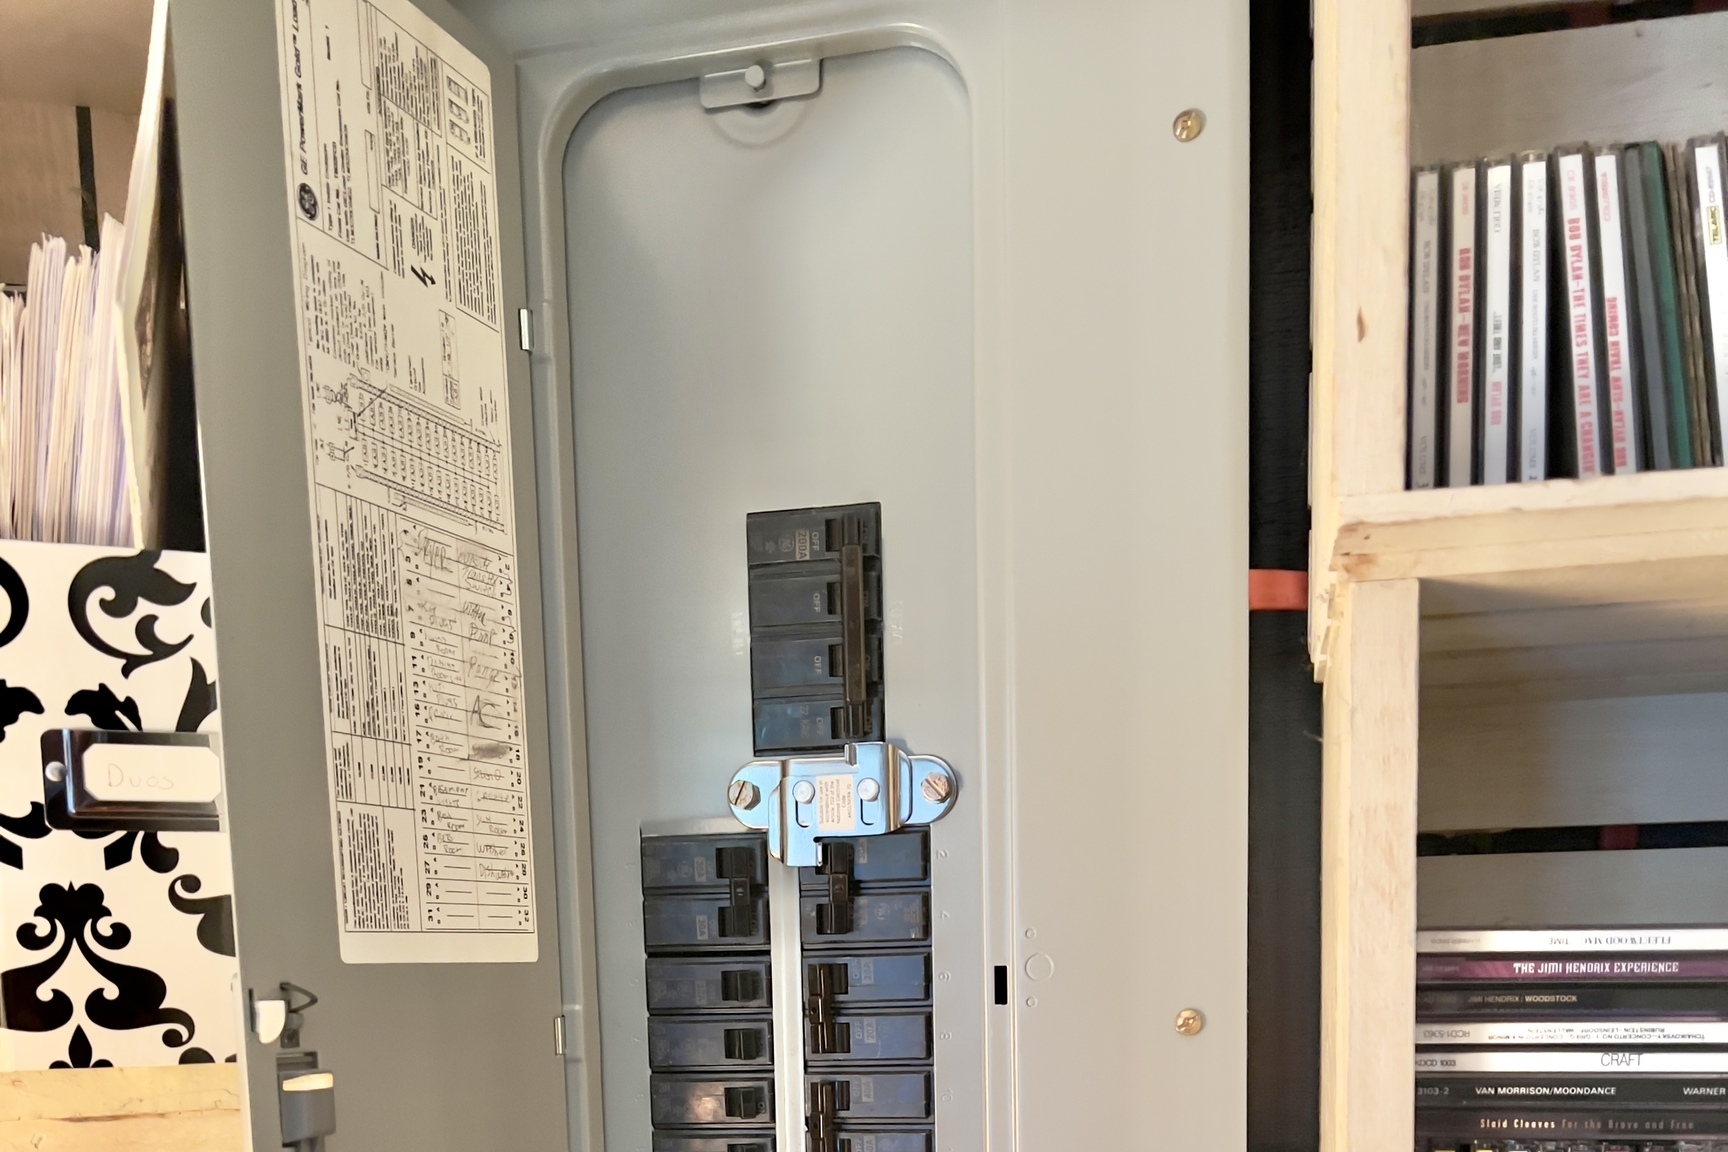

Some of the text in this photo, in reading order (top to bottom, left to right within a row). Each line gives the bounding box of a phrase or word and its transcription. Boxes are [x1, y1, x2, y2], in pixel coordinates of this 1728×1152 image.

[1568, 218, 1581, 240] BOB
[1574, 313, 1587, 347] TIMES
[1577, 351, 1590, 378] THEY
[1609, 340, 1622, 371] TRAIN
[1578, 385, 1591, 404] ARE
[797, 531, 808, 560] 200A
[811, 531, 820, 552] OFF
[812, 593, 821, 613] OFF
[813, 655, 822, 675] OFF
[1513, 961, 1679, 974] THE JIMI HENDRIX EXPERIENCE
[1600, 1053, 1643, 1067] CRAFT
[1475, 1086, 1726, 1095] VAN MORRISON/MOONDANCE WARNER
[1480, 1119, 1508, 1129] Slaid
[1513, 1119, 1556, 1129] Cleaves
